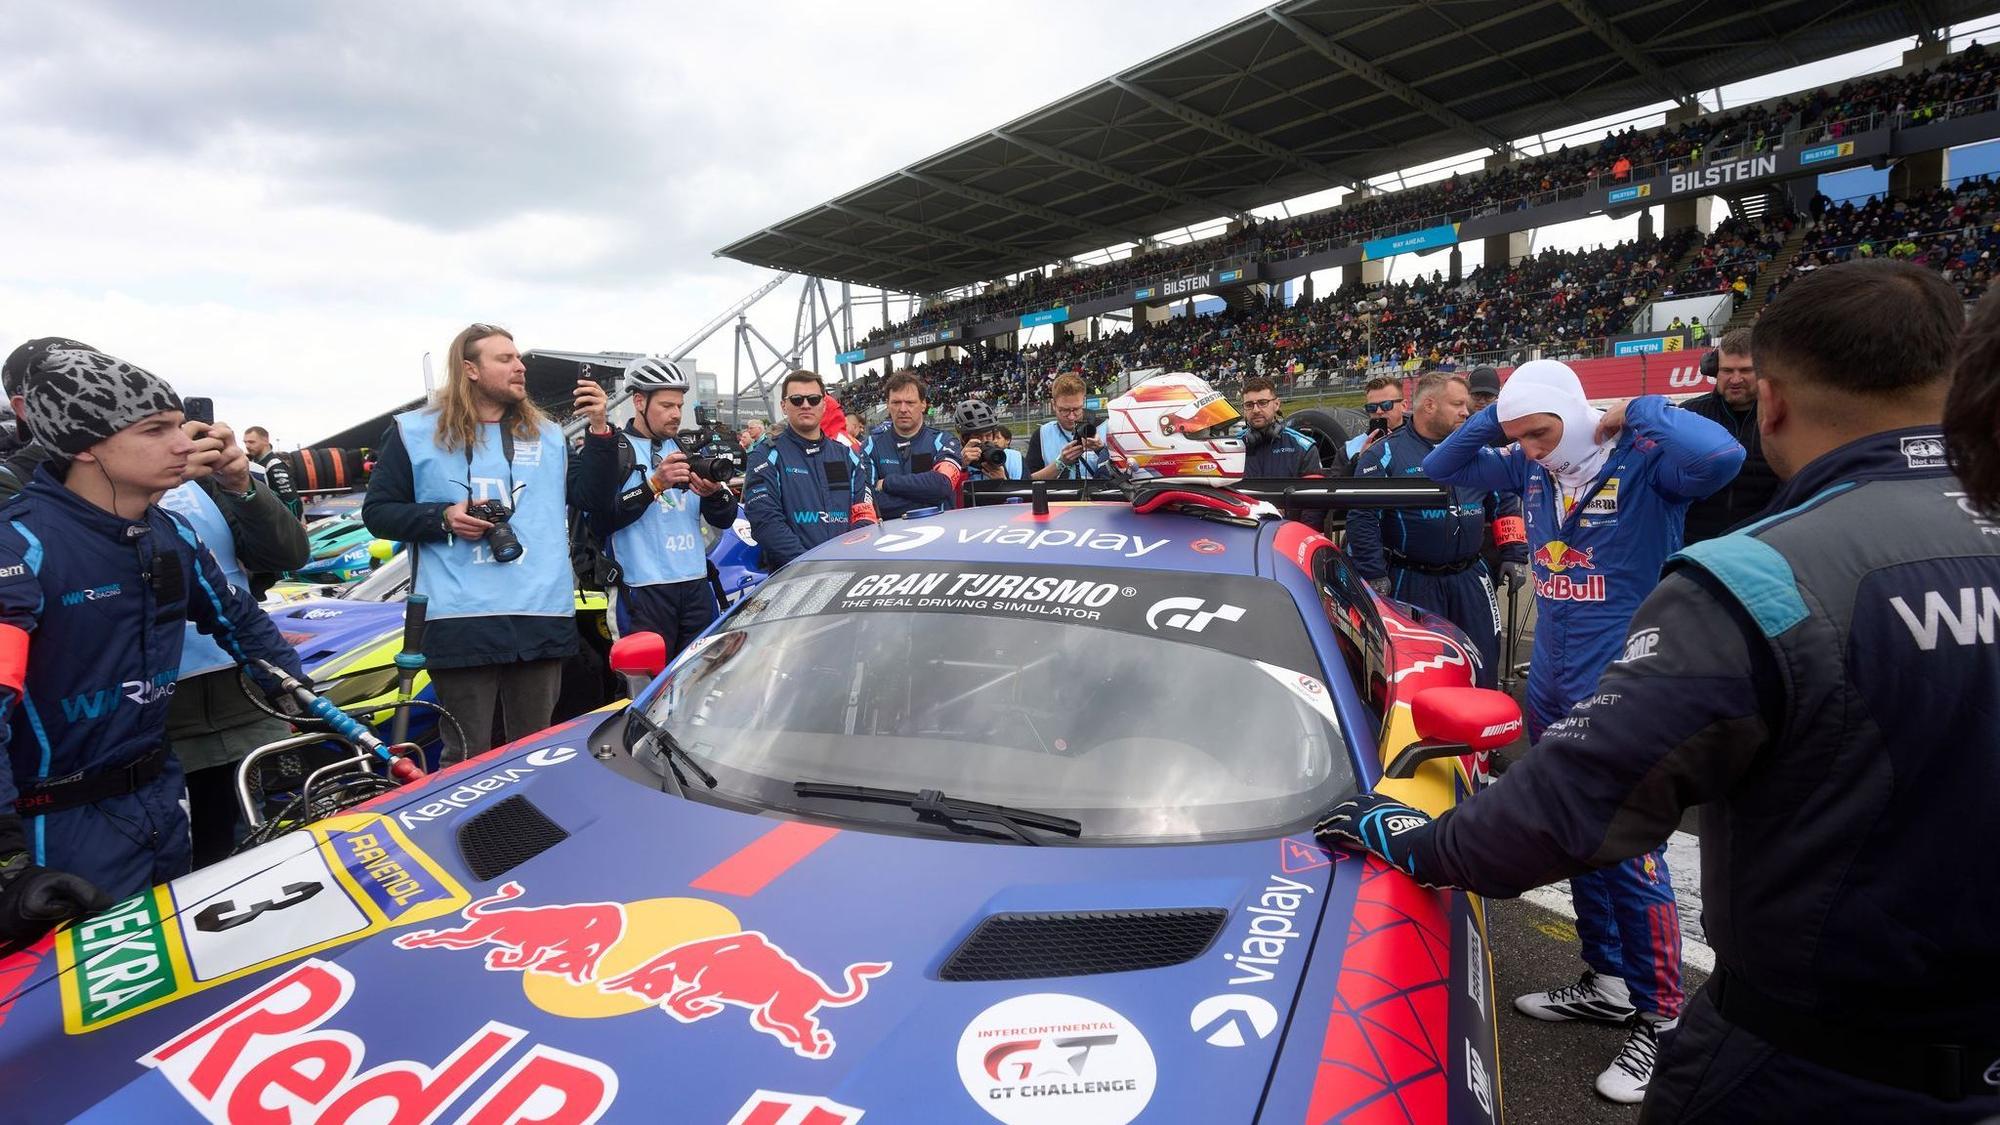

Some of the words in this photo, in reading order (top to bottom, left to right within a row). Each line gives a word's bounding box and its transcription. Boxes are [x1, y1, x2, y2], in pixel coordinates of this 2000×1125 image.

[1803, 149, 1835, 162] BILSTEIN
[1671, 155, 1776, 193] BILSTEIN
[1163, 274, 1210, 296] BILSTEIN
[909, 333, 936, 347] BILSTEIN
[1620, 343, 1658, 354] BILSTEIN
[470, 477, 524, 510] TV
[665, 534, 695, 552] 420
[957, 525, 1171, 558] viaplay
[847, 573, 949, 599] GRAN
[842, 599, 873, 609] THE
[874, 598, 915, 608] REAL
[917, 598, 988, 610] DRIVING
[992, 601, 1101, 621] SIMULATOR
[399, 768, 535, 830] viaplay
[347, 833, 426, 906] RAVENOL
[194, 882, 324, 932] 3
[1224, 874, 1315, 985] viaplay
[80, 895, 166, 1018] DEKRA
[978, 1022, 1115, 1038] INTERCONTINENTAL
[989, 1087, 1015, 1100] GT
[1020, 1078, 1137, 1099] CHALLENGE
